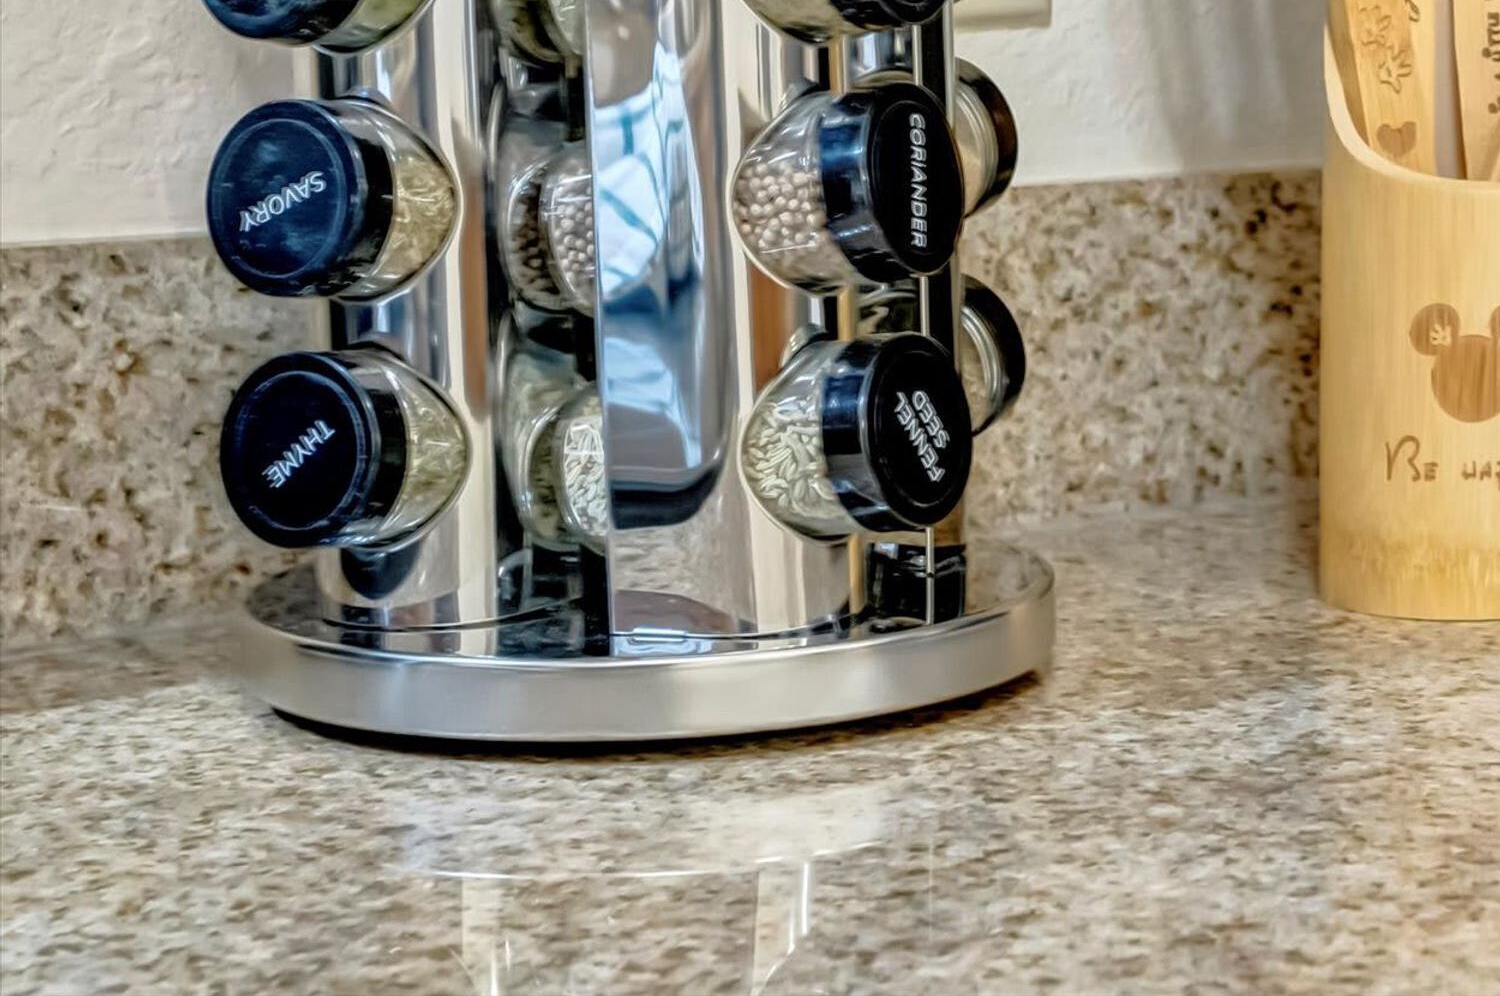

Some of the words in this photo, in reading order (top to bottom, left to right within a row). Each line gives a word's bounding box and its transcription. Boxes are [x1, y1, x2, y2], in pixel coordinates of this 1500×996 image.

[239, 171, 327, 232] SAVORY
[909, 113, 928, 248] CORIANDER
[894, 392, 945, 482] FENNEL
[912, 390, 951, 449] SEED
[262, 420, 335, 488] THYME
